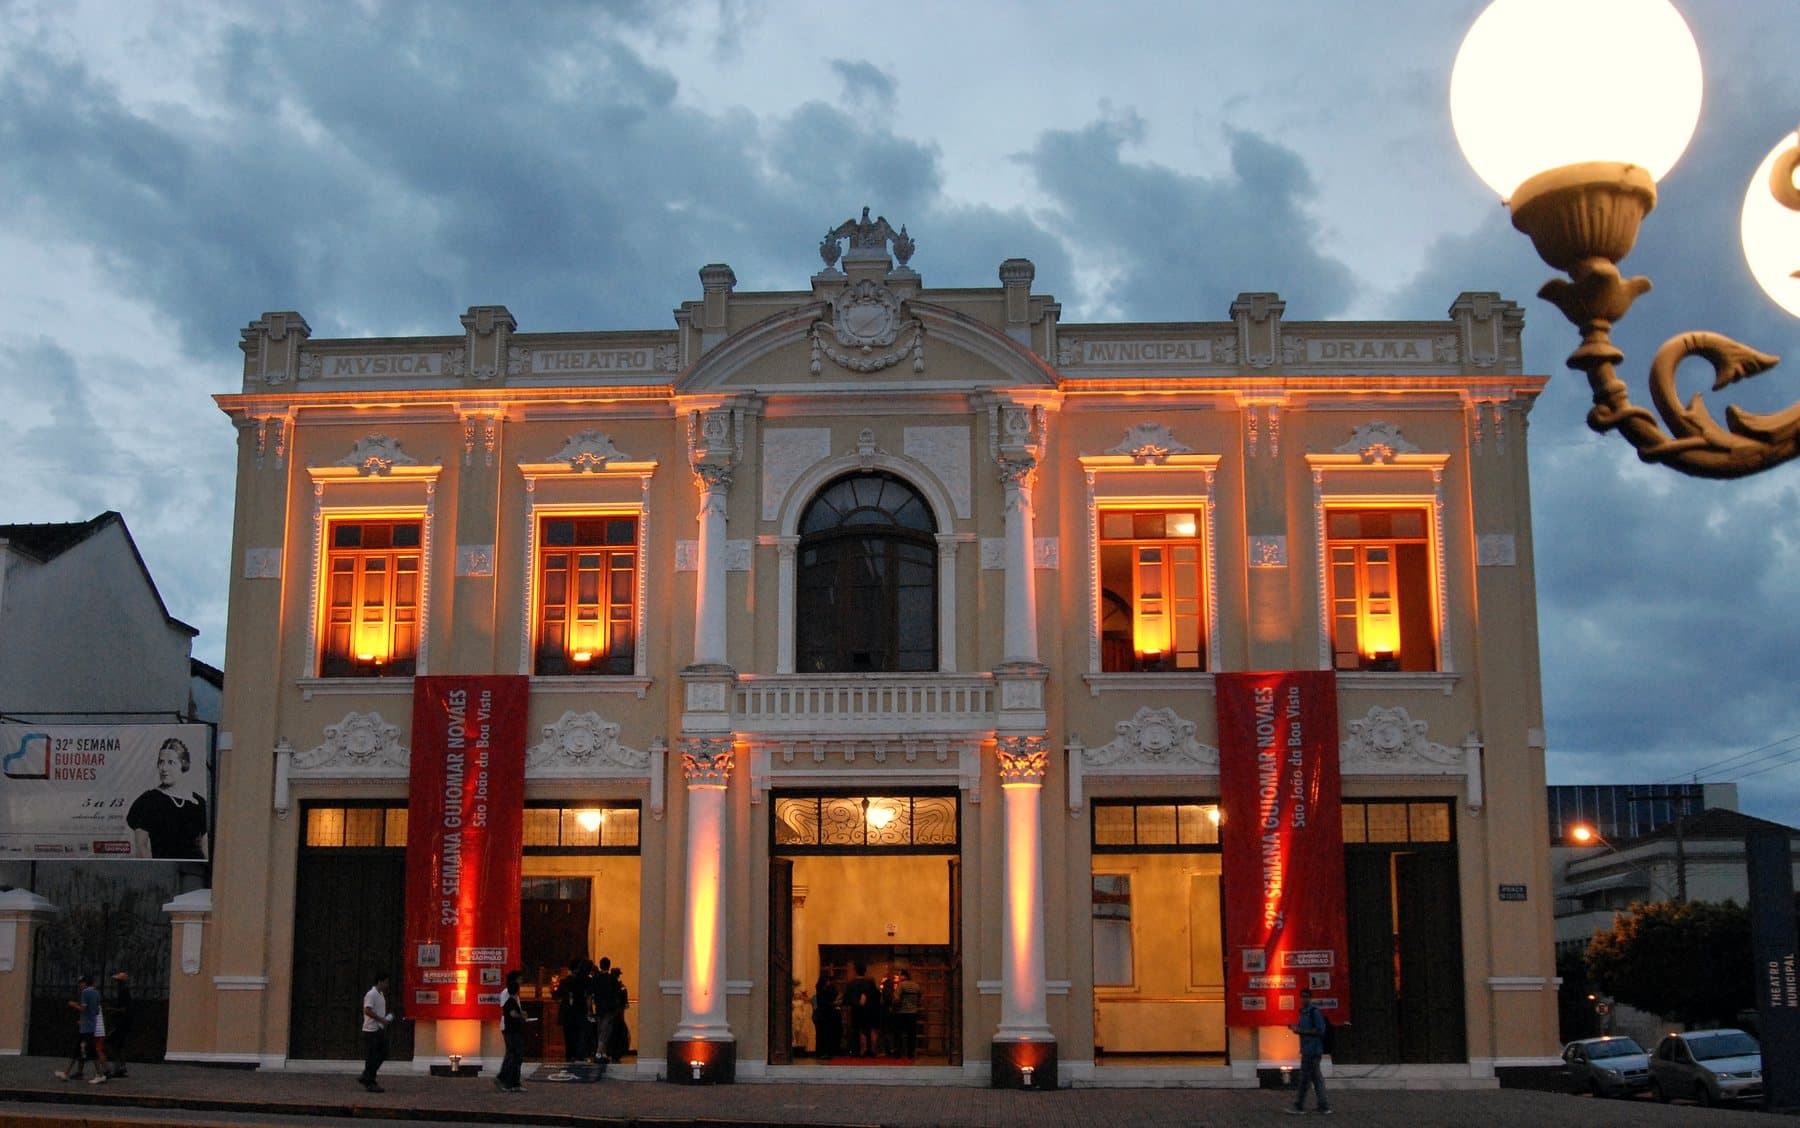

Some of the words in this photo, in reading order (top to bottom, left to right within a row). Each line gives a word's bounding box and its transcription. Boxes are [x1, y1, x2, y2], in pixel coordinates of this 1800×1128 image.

[540, 350, 647, 371] THEATRO
[1087, 341, 1209, 361] MVNICIPAL
[1320, 340, 1423, 360] DRAMA
[332, 354, 433, 376] MVSICA
[477, 689, 492, 720] Vista
[1286, 686, 1300, 719] Vista
[447, 689, 467, 748] NOVAES
[1255, 686, 1275, 748] NOVAES
[77, 738, 121, 751] SEMANA
[476, 723, 491, 748] Boa
[1287, 722, 1302, 747] Boa
[55, 753, 105, 766] GUIOMAR
[474, 751, 490, 768] da
[1288, 750, 1303, 767] da
[54, 768, 97, 781] NOVAES
[473, 770, 489, 801] João
[1289, 770, 1305, 801] João
[444, 752, 465, 828] GUIOMAR
[1258, 752, 1280, 829] GUIOMAR
[472, 804, 488, 827] São
[1291, 804, 1306, 828] São
[442, 831, 461, 895] SEMANA
[1263, 833, 1283, 898] SEMANA
[1768, 961, 1782, 1008] THEATRO
[1783, 953, 1798, 1007] MUNICIPAL
